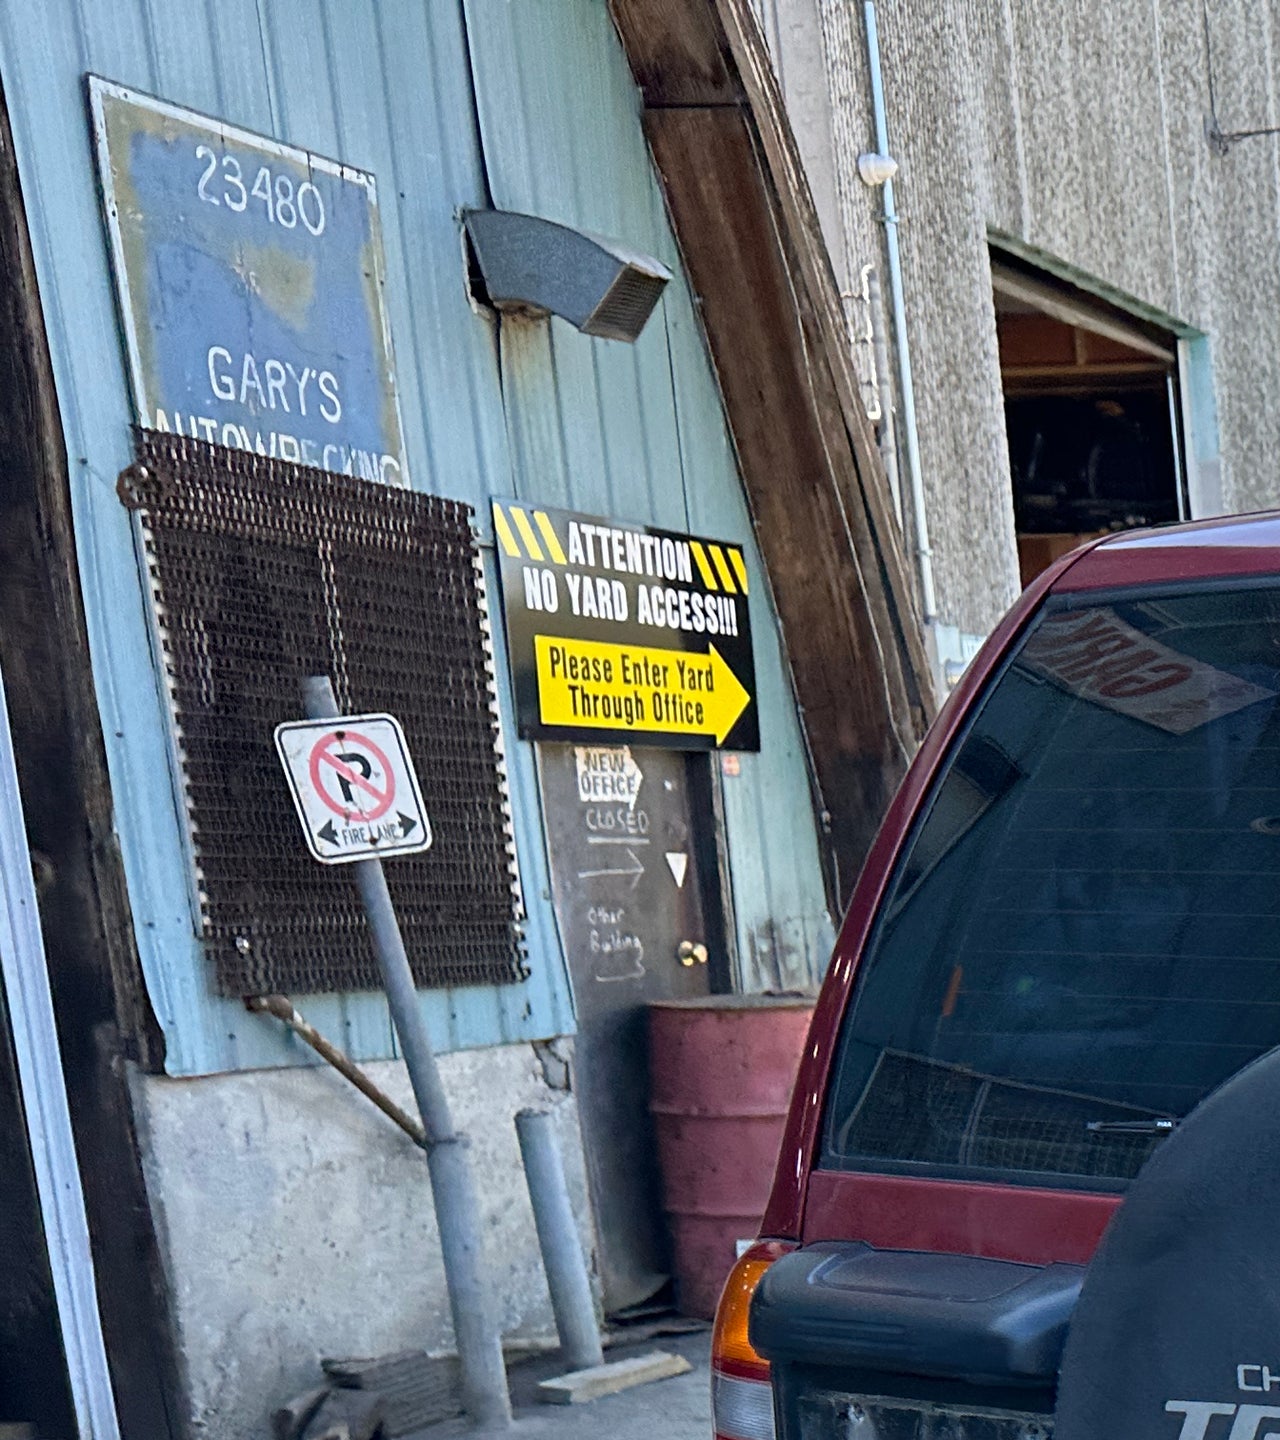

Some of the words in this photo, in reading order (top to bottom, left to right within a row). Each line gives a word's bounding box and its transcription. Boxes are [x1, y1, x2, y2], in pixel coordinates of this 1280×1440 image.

[195, 144, 326, 237] 23480
[207, 345, 342, 425] GARY'S
[567, 520, 693, 583] ATTENTION
[523, 565, 559, 613] NO
[565, 572, 629, 622] YARD
[637, 583, 739, 637] ACCESS!!!
[549, 645, 613, 684] Please
[621, 653, 669, 689] Enter
[676, 659, 715, 692] Yard
[567, 683, 645, 726] Through
[653, 691, 705, 725] Office
[581, 770, 636, 796] OFFICE
[585, 751, 625, 773] NEW
[342, 827, 369, 846] FIRE
[586, 807, 650, 834] CLOSED
